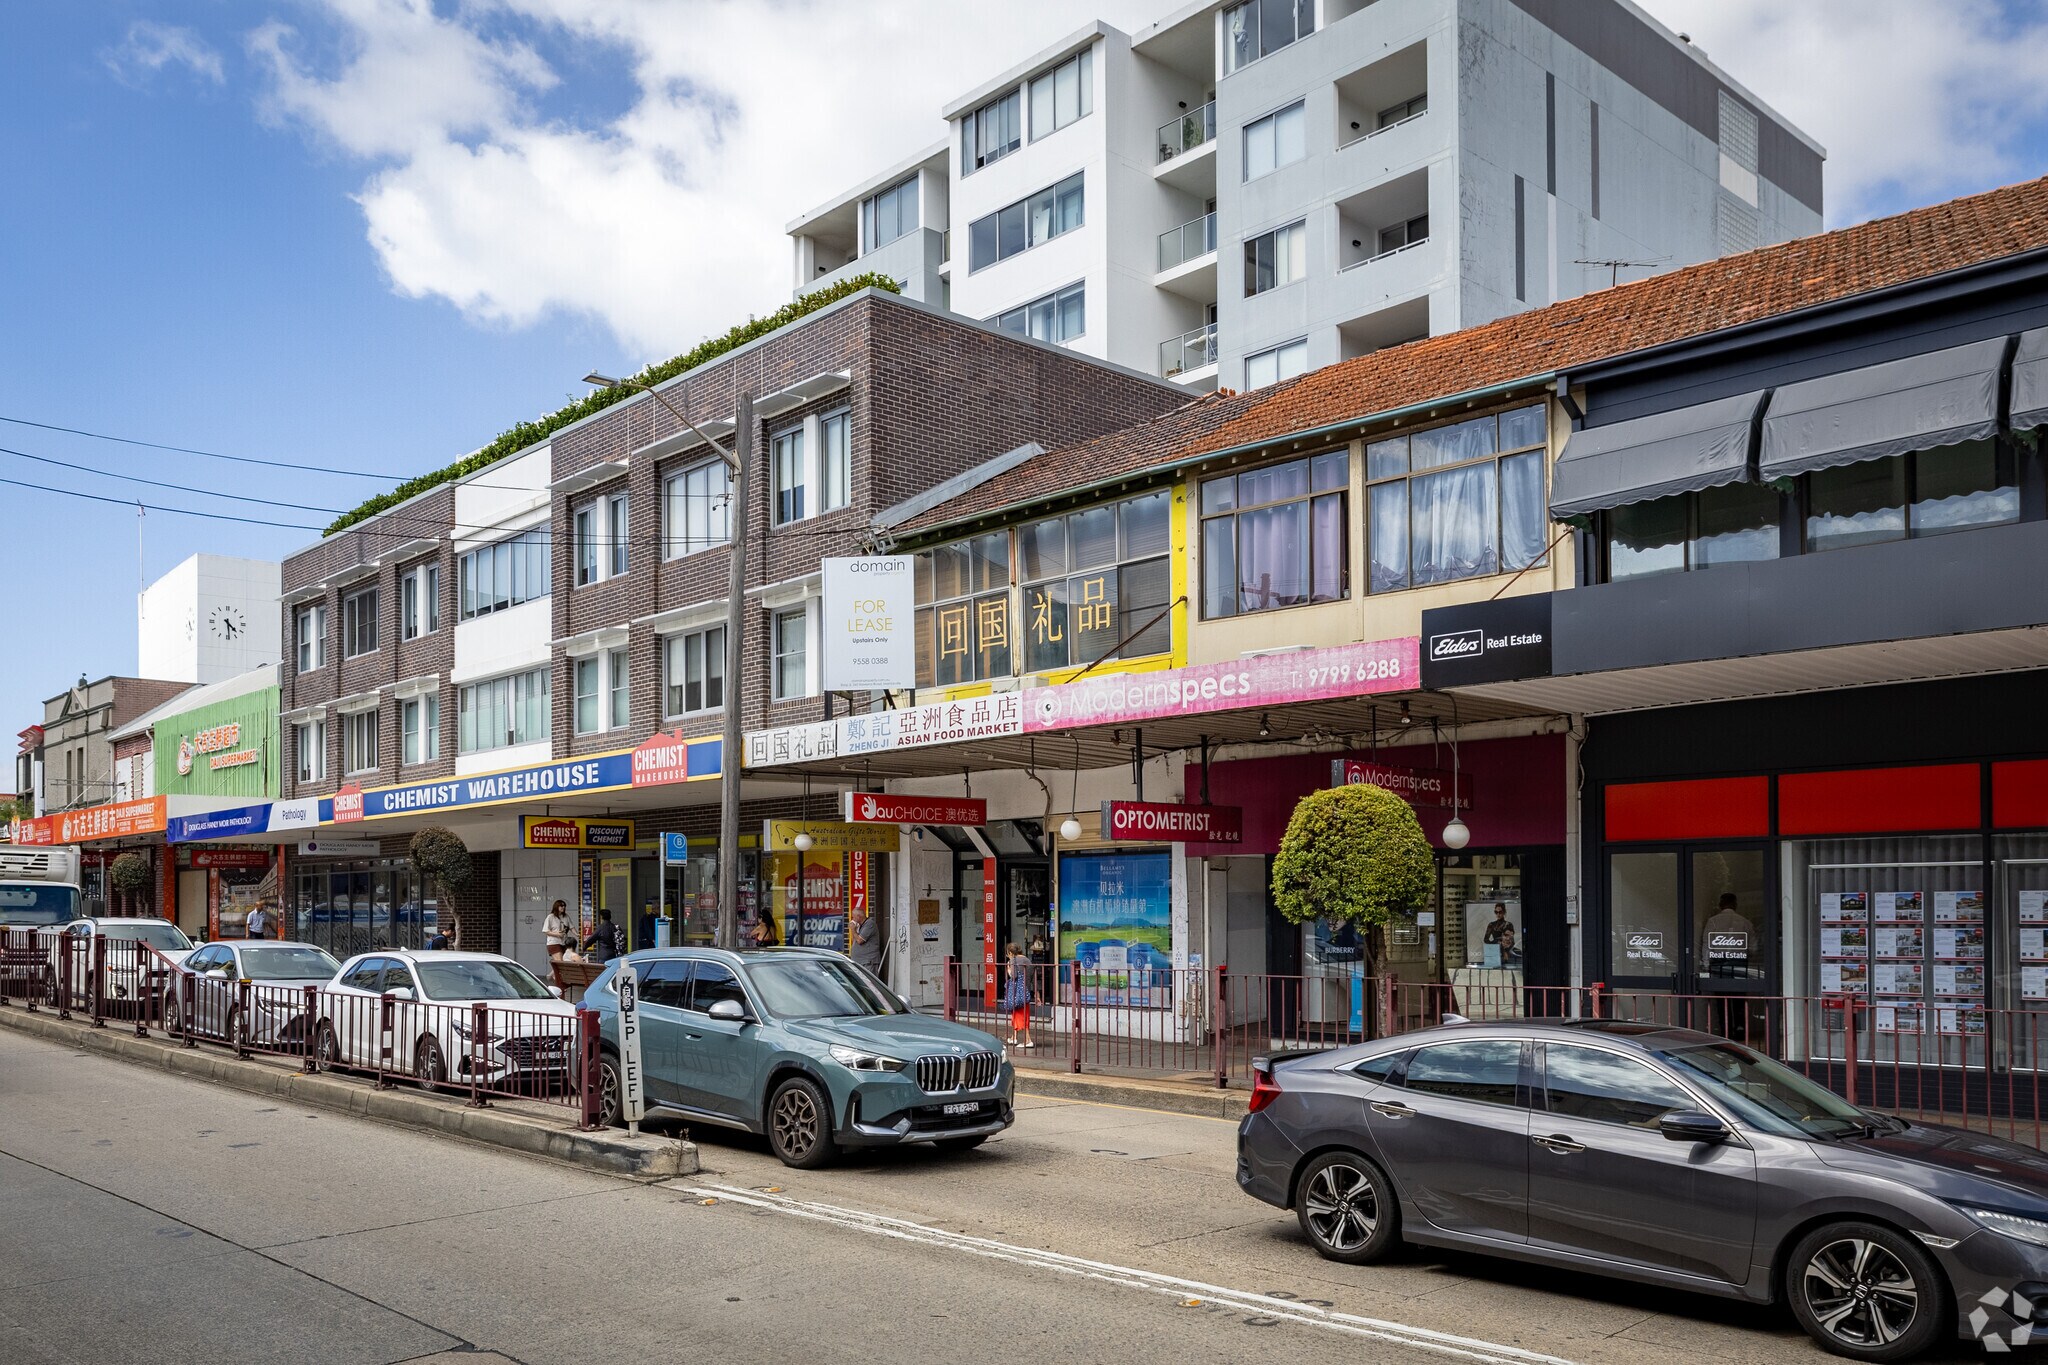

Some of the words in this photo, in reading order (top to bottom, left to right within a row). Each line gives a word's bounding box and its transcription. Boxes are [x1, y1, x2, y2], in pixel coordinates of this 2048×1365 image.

[850, 558, 905, 573] domain
[854, 599, 886, 614] FOR
[848, 617, 893, 632] LEASE
[940, 576, 1111, 660] 回国礼品
[875, 636, 889, 644] Only
[1434, 637, 1480, 656] Elders
[1486, 635, 1508, 649] Real
[1510, 633, 1543, 647] Estate
[852, 657, 870, 665] 9558
[872, 657, 889, 665] 0388
[1068, 669, 1251, 715] Modernspecs
[1307, 664, 1352, 687] 9799
[1355, 657, 1401, 681] 6288
[899, 696, 1019, 734] 亞洲食品店
[847, 714, 892, 741] 鄭記
[897, 733, 931, 746] ASIAN
[933, 728, 965, 741] FOOD
[967, 722, 1019, 738] MARKET
[751, 726, 836, 764] 回国礼品
[849, 739, 879, 752] ZHENG
[880, 738, 890, 749] JI
[221, 749, 256, 767] SUPERMARKET
[634, 744, 685, 770] CHEMIST
[635, 769, 686, 783] WAREHOUSE
[1365, 768, 1442, 792] Modernspecs
[384, 784, 460, 811] CHEMIST
[468, 763, 600, 800] WAREHOUSE
[125, 802, 155, 817] SUPERMARKET
[334, 792, 362, 811] CHEMIST
[282, 807, 307, 821] Pathology
[335, 810, 362, 821] WAREHOUSE
[945, 807, 980, 823] 澳优选
[1114, 809, 1211, 831] OPTOMETRIST
[533, 826, 577, 837] CHEMIST
[589, 827, 626, 835] DISCOUNT
[676, 837, 683, 846] B
[854, 851, 863, 890] OPEN
[787, 878, 841, 898] CEMIST
[1100, 880, 1125, 896] 贝拉米
[853, 893, 864, 908] 7
[1628, 935, 1660, 946] Elders
[1711, 935, 1744, 946] Elders
[1324, 946, 1355, 954] BURBERRY
[1709, 951, 1724, 959] Real
[1725, 951, 1747, 959] Estate
[622, 976, 636, 1041] KEP
[626, 1050, 638, 1117] LEFT
